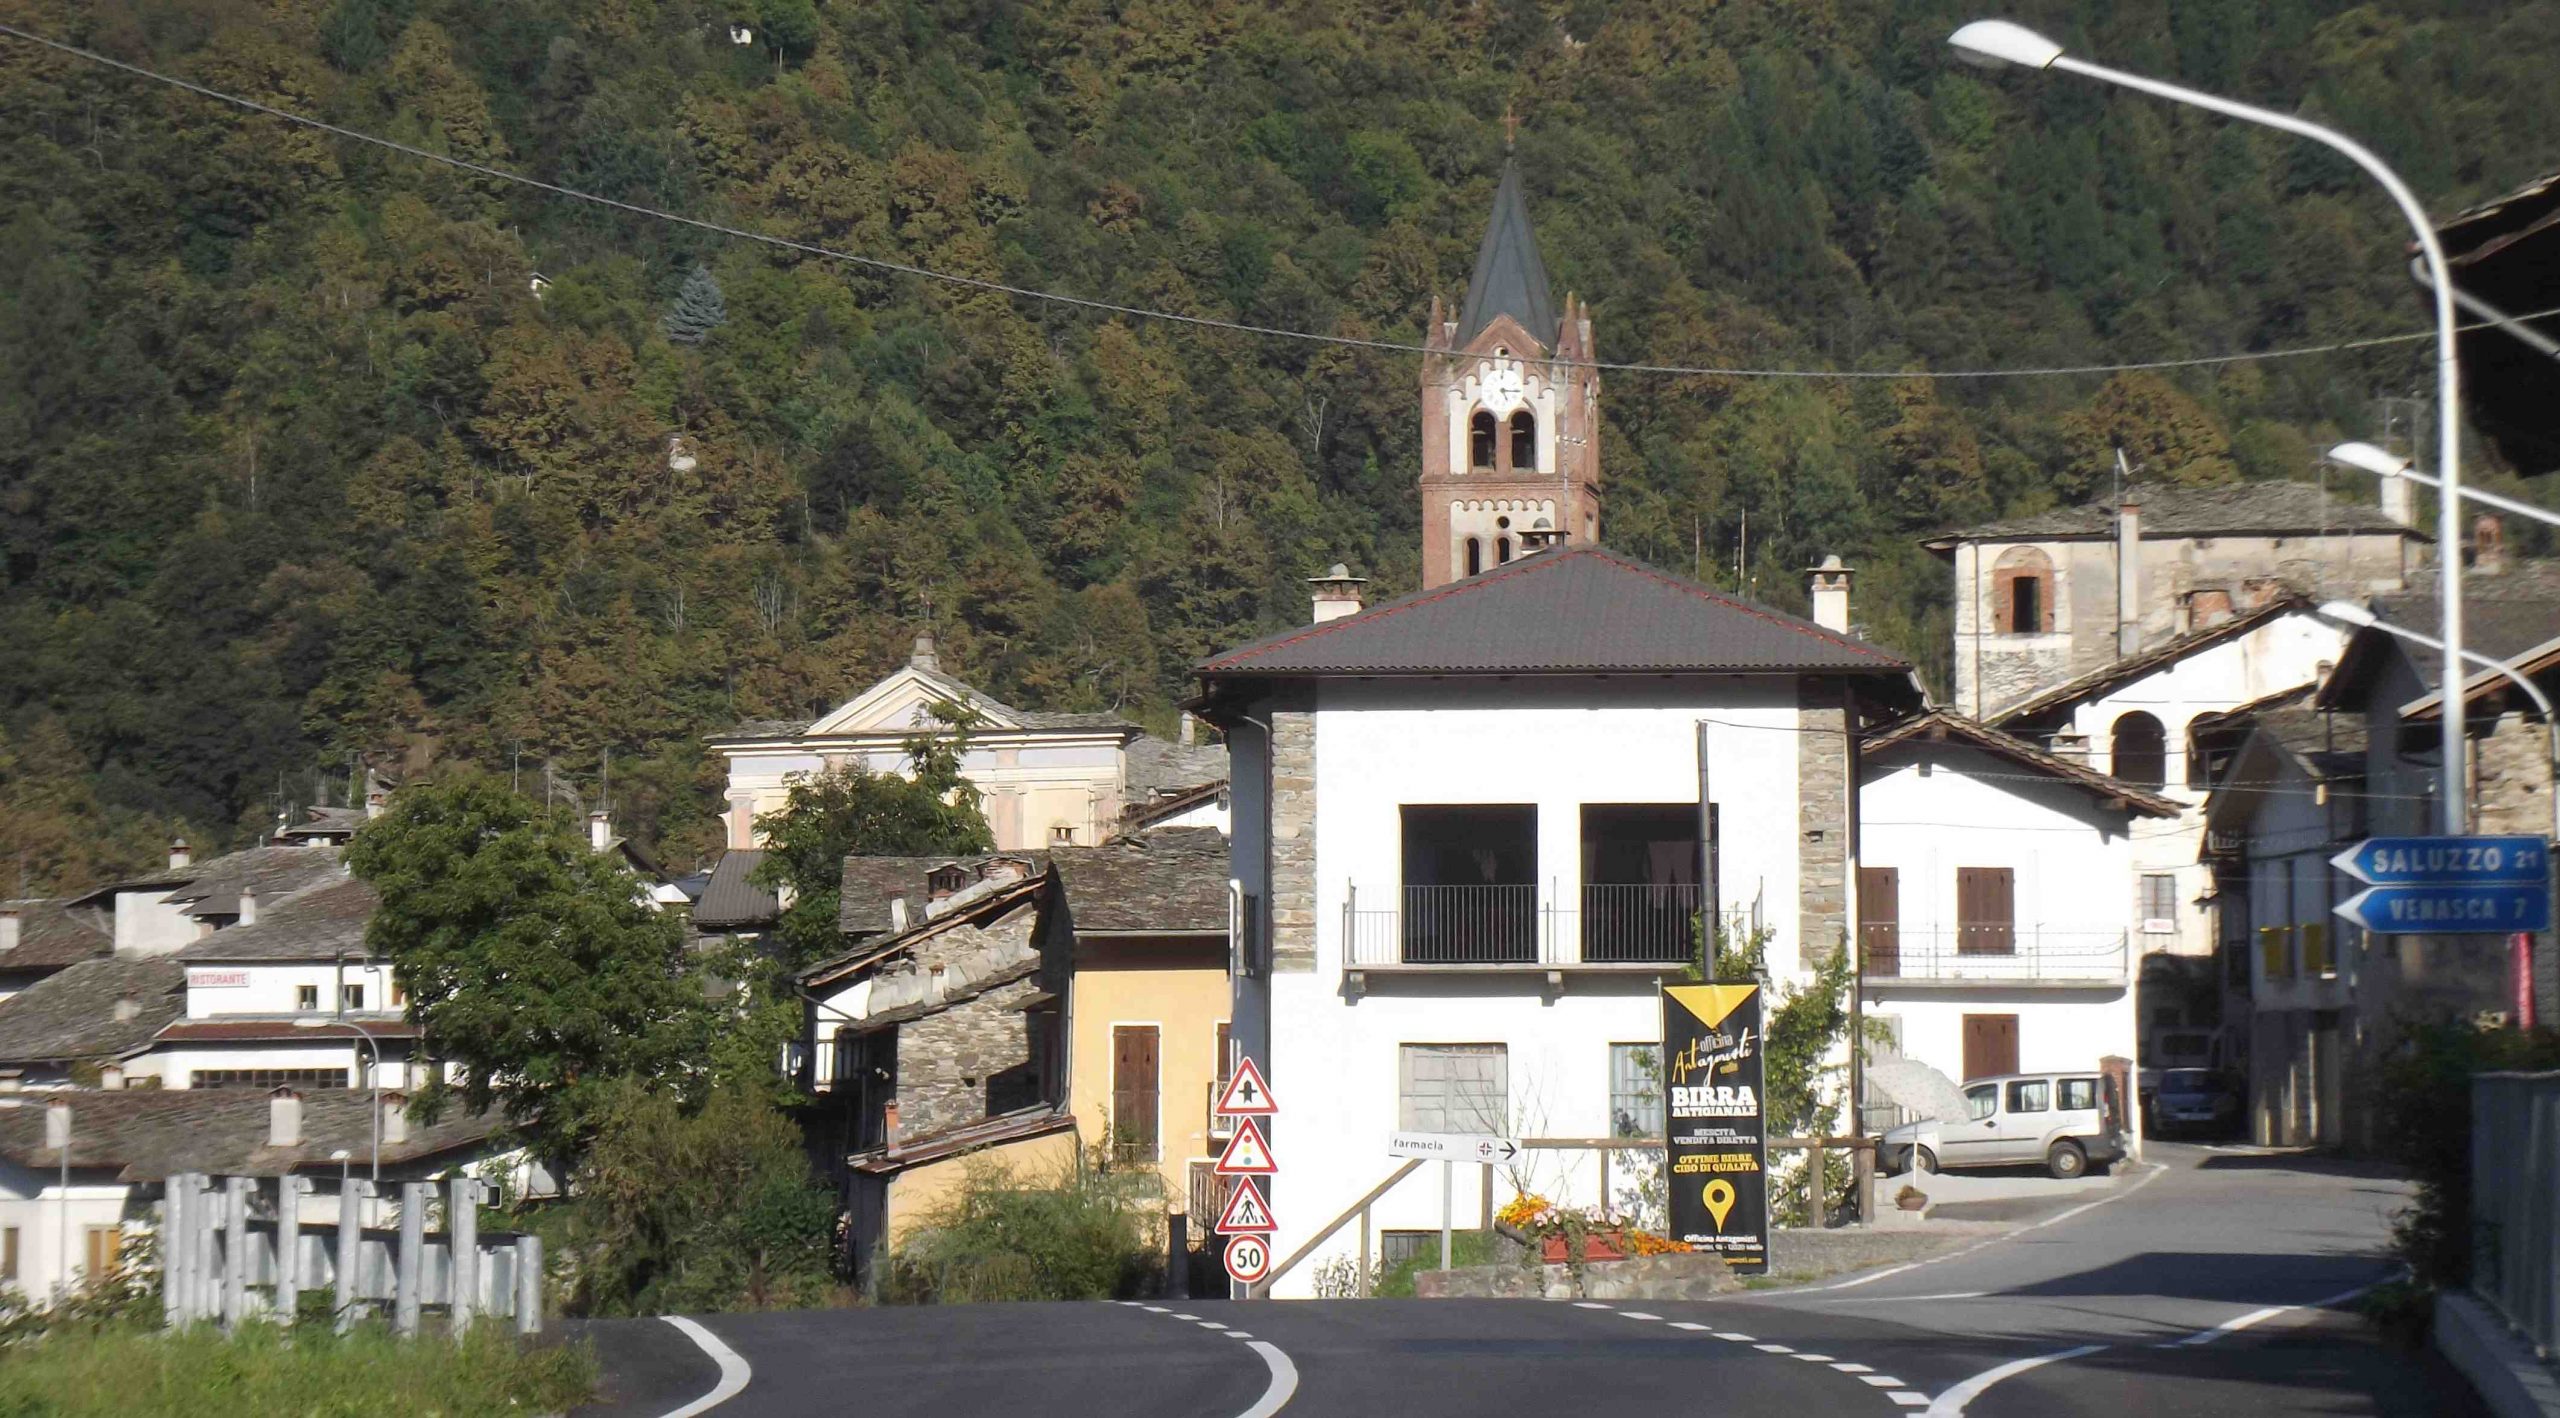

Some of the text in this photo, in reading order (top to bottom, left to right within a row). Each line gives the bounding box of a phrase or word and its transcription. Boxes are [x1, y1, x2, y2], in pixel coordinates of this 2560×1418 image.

[2373, 847, 2538, 873] SALUZZO 21
[2389, 898, 2528, 921] VENASCA 7
[190, 973, 247, 985] RISTORANTE
[1671, 1086, 1757, 1107] BIRRA
[1672, 1106, 1757, 1117] ARTIGIANALE
[1693, 1128, 1736, 1137] MESCITA
[1394, 1138, 1444, 1150] farmacia
[1673, 1136, 1758, 1145] VENDITA DIRETTA
[1720, 1153, 1752, 1163] BIRRE
[1673, 1163, 1698, 1173] CIBO
[1699, 1162, 1711, 1172] DI
[1683, 1234, 1757, 1244] Officina Antagonisti
[1236, 1248, 1261, 1268] 50
